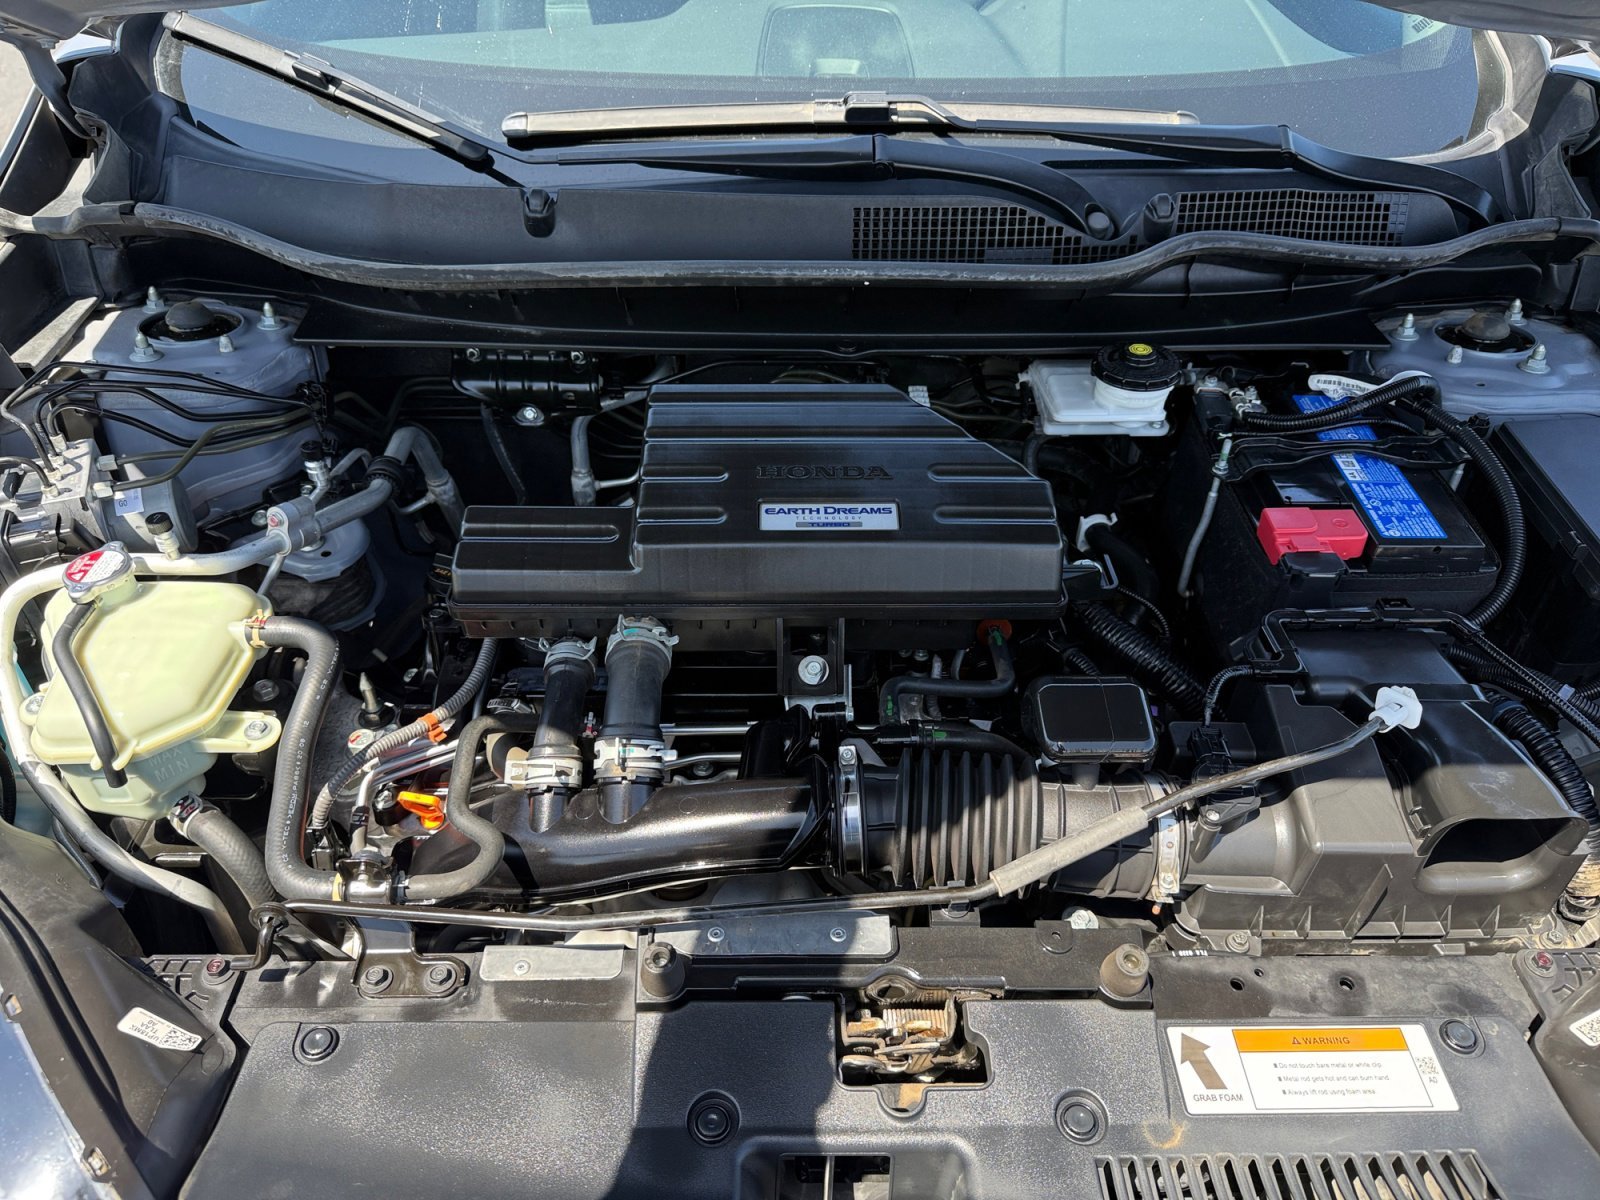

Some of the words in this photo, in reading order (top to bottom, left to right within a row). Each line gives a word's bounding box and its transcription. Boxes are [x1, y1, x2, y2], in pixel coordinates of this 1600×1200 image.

[757, 465, 894, 480] HONDA
[764, 507, 820, 515] EARTH
[823, 506, 893, 515] DREAMS
[148, 746, 183, 768] MAX
[153, 757, 190, 782] MIN
[1302, 1036, 1350, 1045] WARNING
[1193, 1093, 1217, 1102] GRAB
[1219, 1093, 1244, 1102] FOAM
[1287, 1089, 1309, 1097] Always
[1330, 1089, 1346, 1097] using
